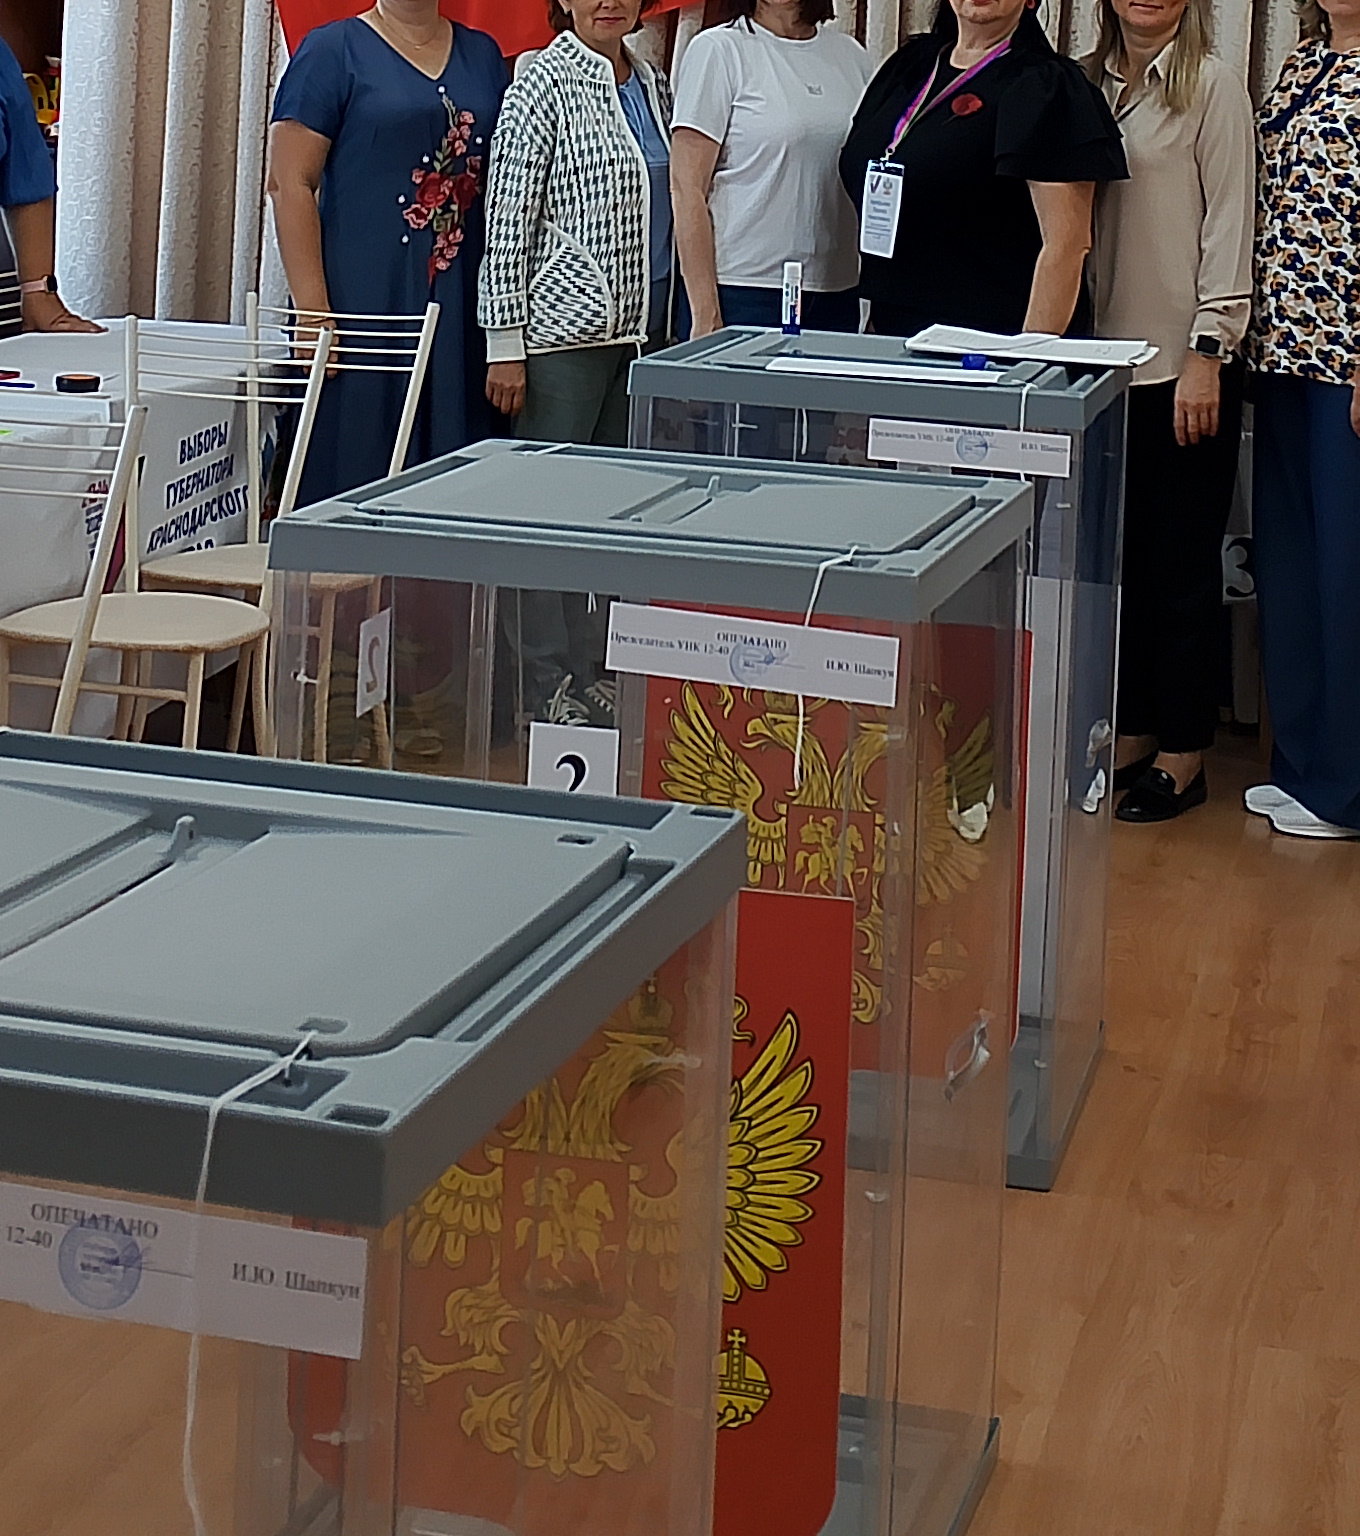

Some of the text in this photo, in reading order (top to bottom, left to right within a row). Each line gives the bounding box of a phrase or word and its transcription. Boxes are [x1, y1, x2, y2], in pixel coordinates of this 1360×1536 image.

[179, 421, 228, 464] ВЫБОРЫ
[166, 453, 234, 510] ГУБЕРНАТОРА
[6, 1227, 53, 1249] 12-40
[31, 1203, 158, 1240] ОПЕЧАТАНО
